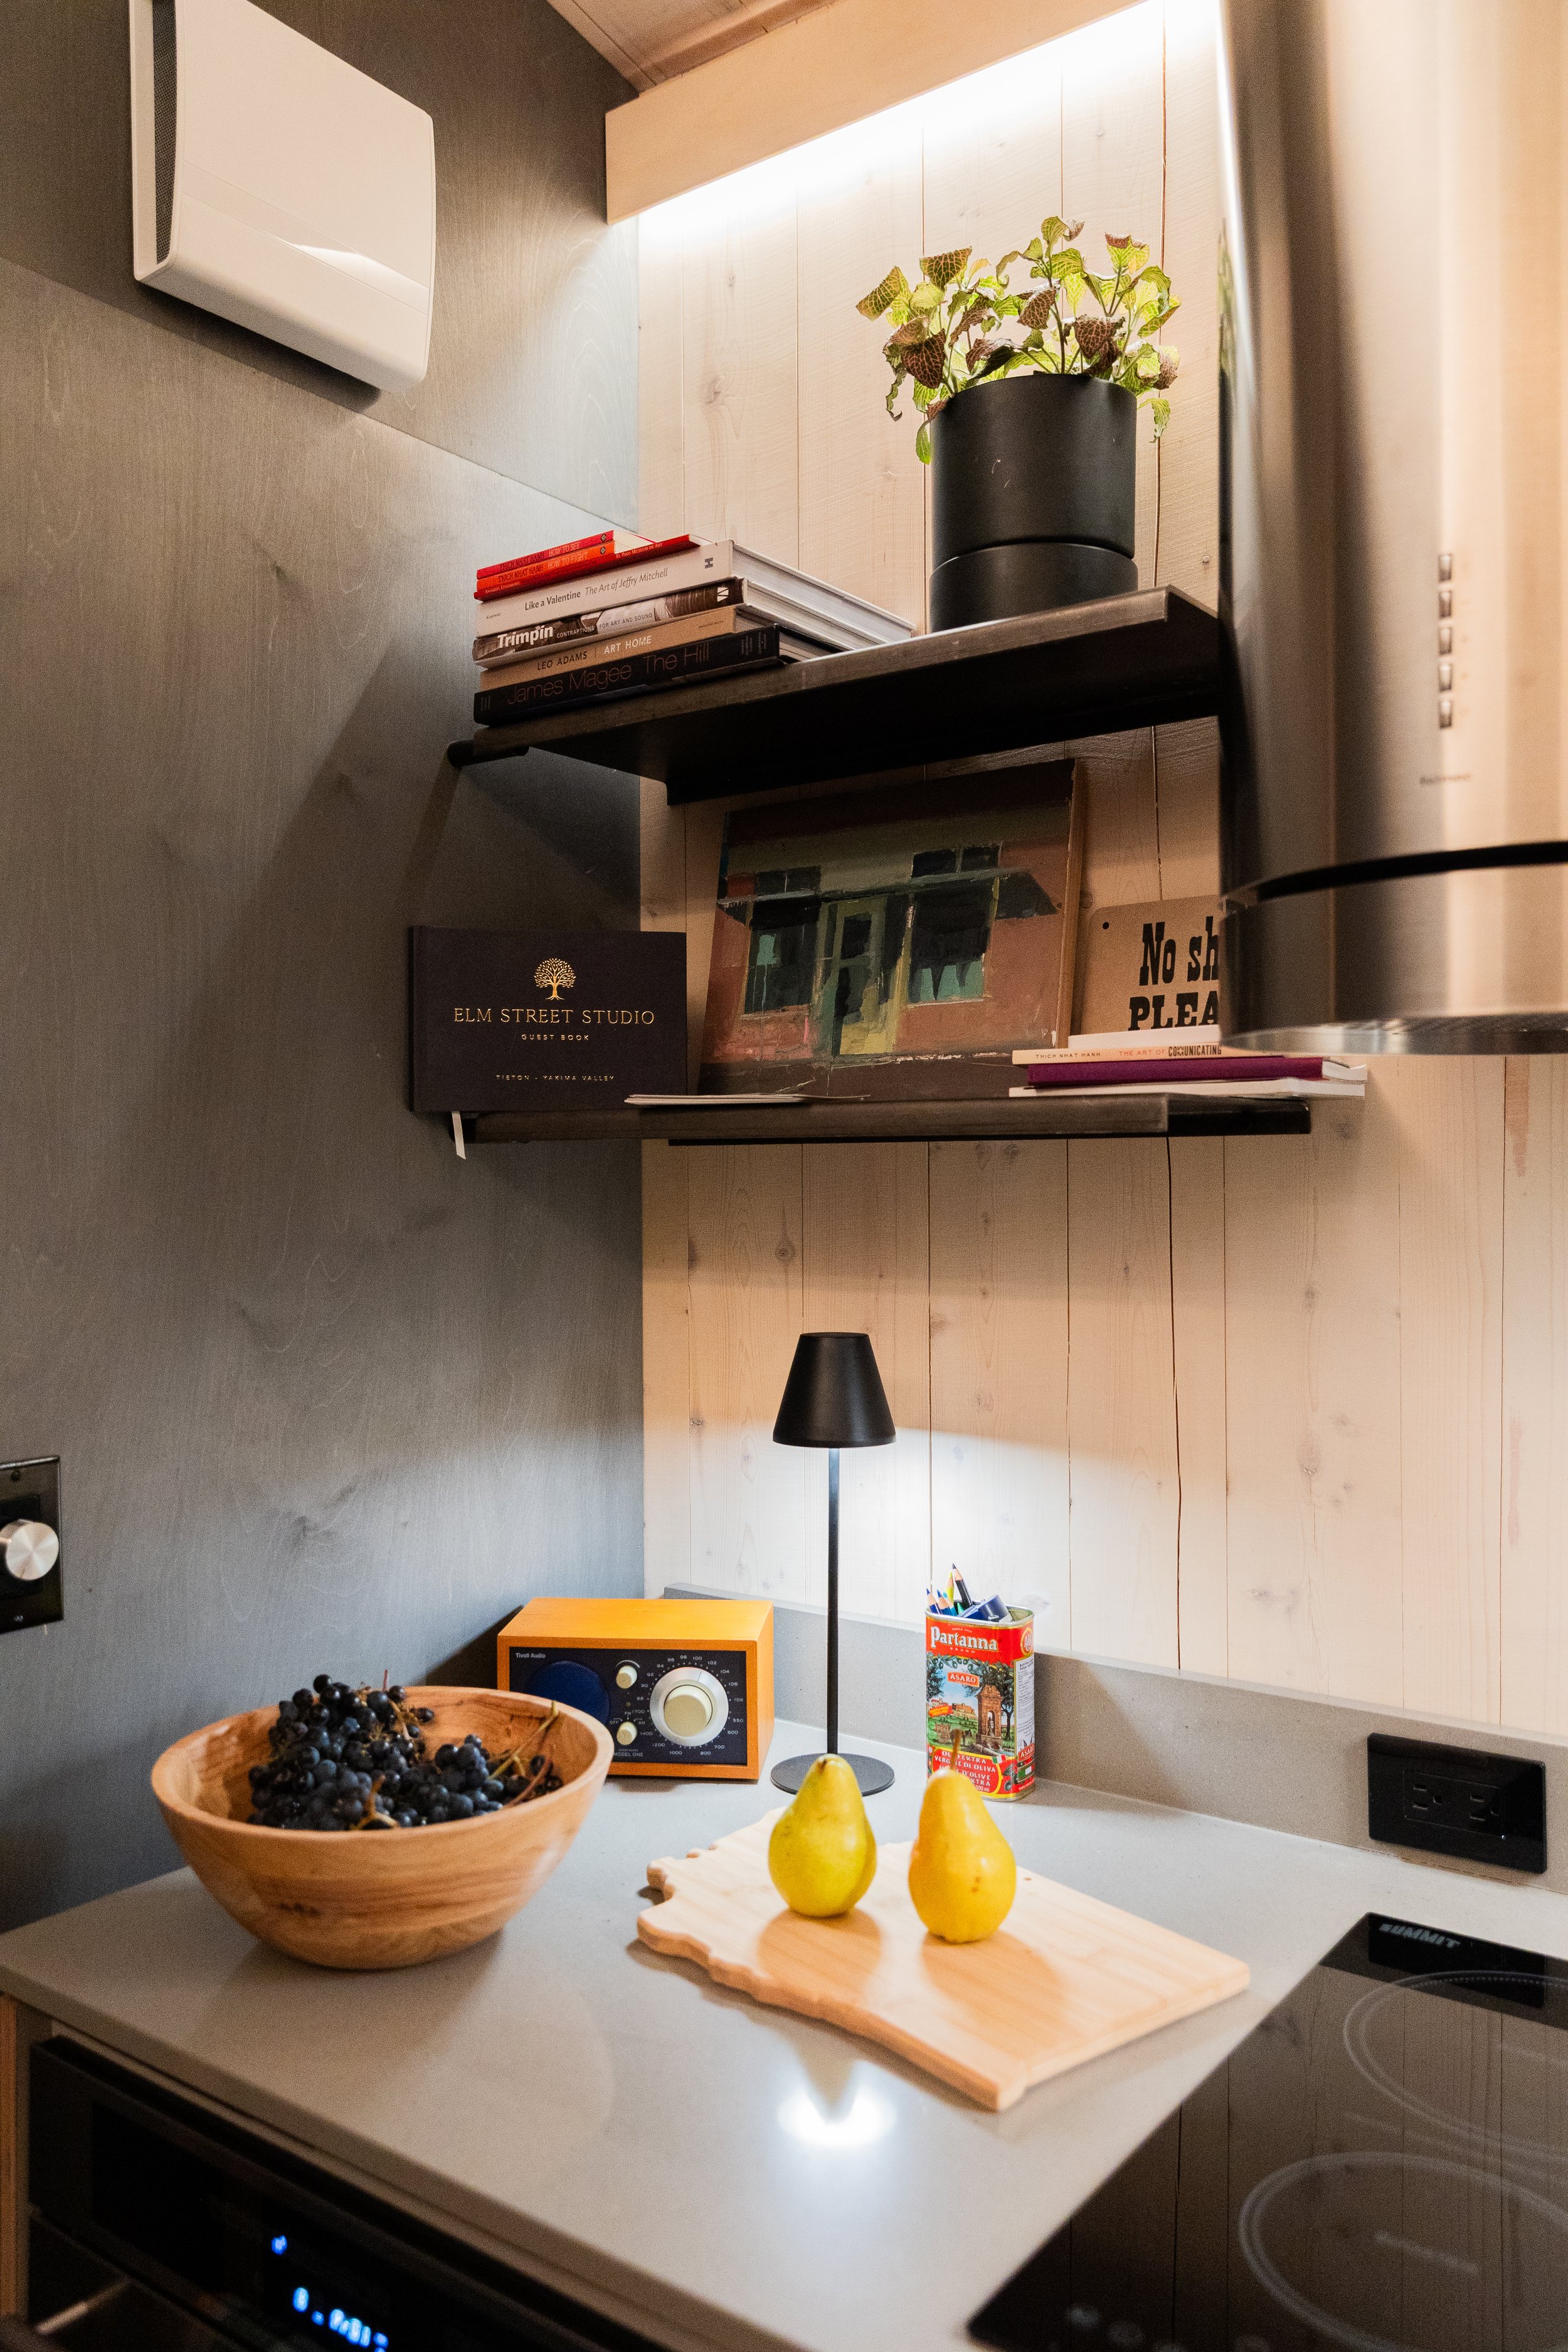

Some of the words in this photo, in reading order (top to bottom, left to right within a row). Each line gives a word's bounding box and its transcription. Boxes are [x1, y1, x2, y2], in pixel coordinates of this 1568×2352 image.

[549, 548, 561, 558] HOW
[571, 542, 581, 551] SEE
[499, 573, 514, 583] THICH
[514, 568, 529, 579] NHAT
[529, 564, 544, 575] HANH
[548, 561, 561, 570] HOW
[571, 551, 588, 563] FIGHT
[524, 600, 539, 611] Like
[546, 590, 581, 605] Valentine
[585, 586, 598, 596] The
[598, 583, 610, 593] Art
[611, 579, 619, 591] of
[618, 576, 638, 588] Jeffry
[638, 568, 669, 583] Mitchell
[556, 625, 595, 638] CONTRAPTIONS
[610, 620, 620, 628] ART
[634, 613, 653, 622] SOUND
[537, 660, 553, 670] LEO
[557, 651, 588, 666] ADAMS
[603, 642, 621, 654] ART
[625, 635, 652, 650] HOME
[507, 679, 563, 704] James
[569, 664, 632, 690] Magee
[643, 654, 677, 674] The
[684, 643, 710, 667] Hill
[1138, 921, 1177, 987] No
[454, 1008, 492, 1022] ELM
[501, 1009, 574, 1024] STREET
[582, 1010, 655, 1024] STUDIO
[930, 1626, 999, 1652] Partanna
[950, 1673, 976, 1683] ASARO
[935, 1756, 962, 1766] VERGE
[973, 1764, 996, 1772] OLIVA
[961, 1755, 987, 1764] EXTRA
[962, 1770, 991, 1781] D'OLIVE
[970, 1777, 991, 1787] XTRA
[1379, 1923, 1461, 1948] SUMMIT
